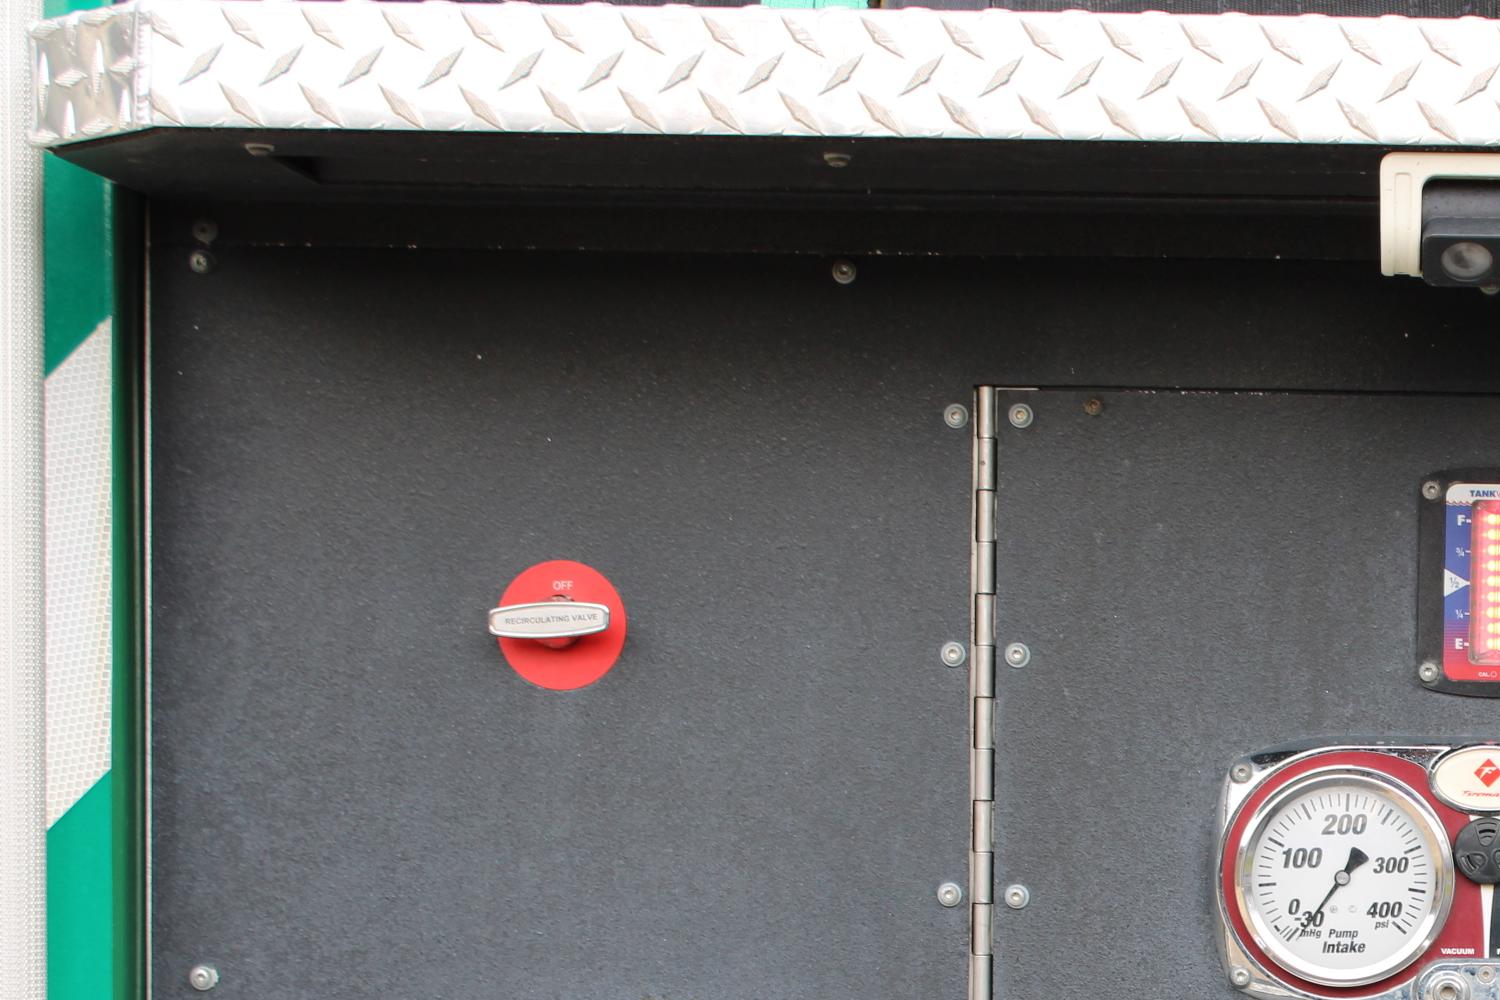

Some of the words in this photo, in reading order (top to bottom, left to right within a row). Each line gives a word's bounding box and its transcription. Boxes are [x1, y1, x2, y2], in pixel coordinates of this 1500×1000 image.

[552, 580, 574, 591] OFF
[504, 615, 570, 625] RECIRCULATING
[571, 613, 598, 622] VALVE
[1321, 814, 1368, 835] 200
[1282, 848, 1323, 868] 100
[1373, 856, 1409, 874] 300
[1288, 898, 1300, 916] 0
[1366, 901, 1402, 918] 400
[1374, 920, 1390, 930] psi
[1328, 929, 1358, 940] Pump
[1322, 942, 1366, 954] Intake
